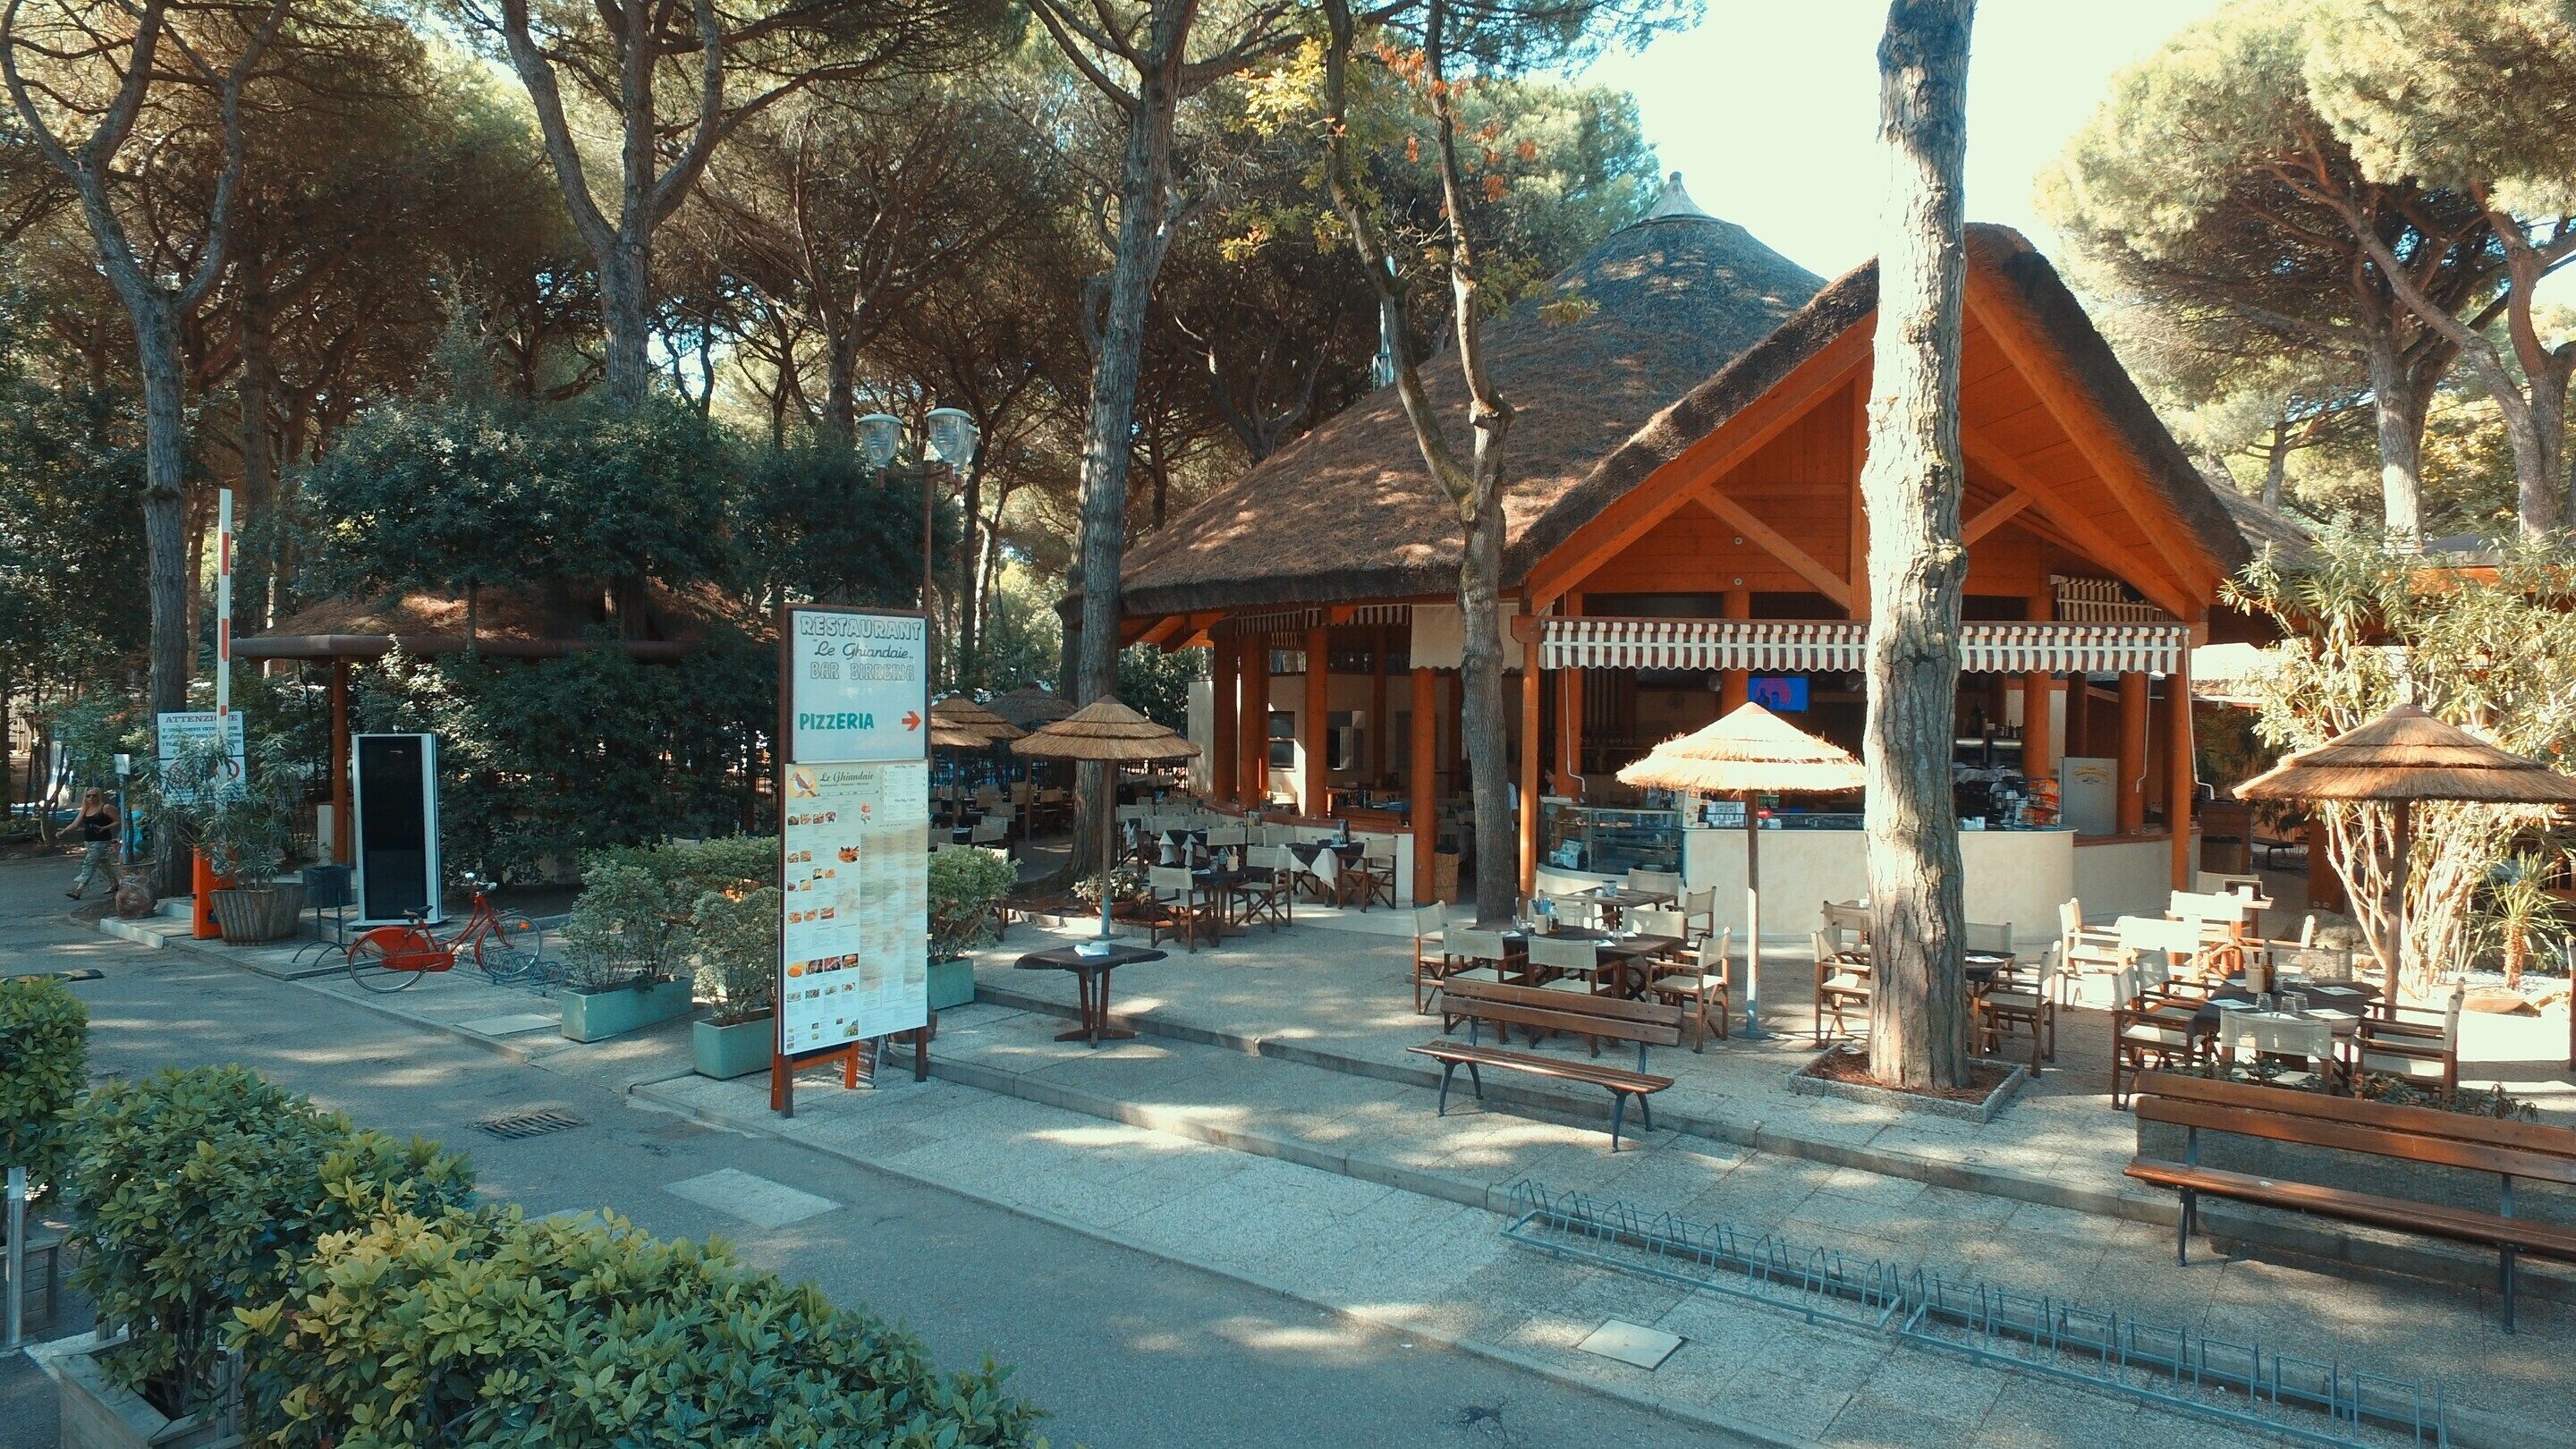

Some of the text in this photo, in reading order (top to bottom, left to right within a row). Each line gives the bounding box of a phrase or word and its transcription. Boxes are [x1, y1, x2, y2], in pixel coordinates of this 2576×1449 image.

[800, 616, 921, 640] RESTAURANT
[810, 662, 914, 681] BAR BIRRERIA
[165, 715, 238, 723] ATTENZIE
[800, 713, 874, 730] PIZZERIA
[820, 771, 873, 783] Le Ghiandaie
